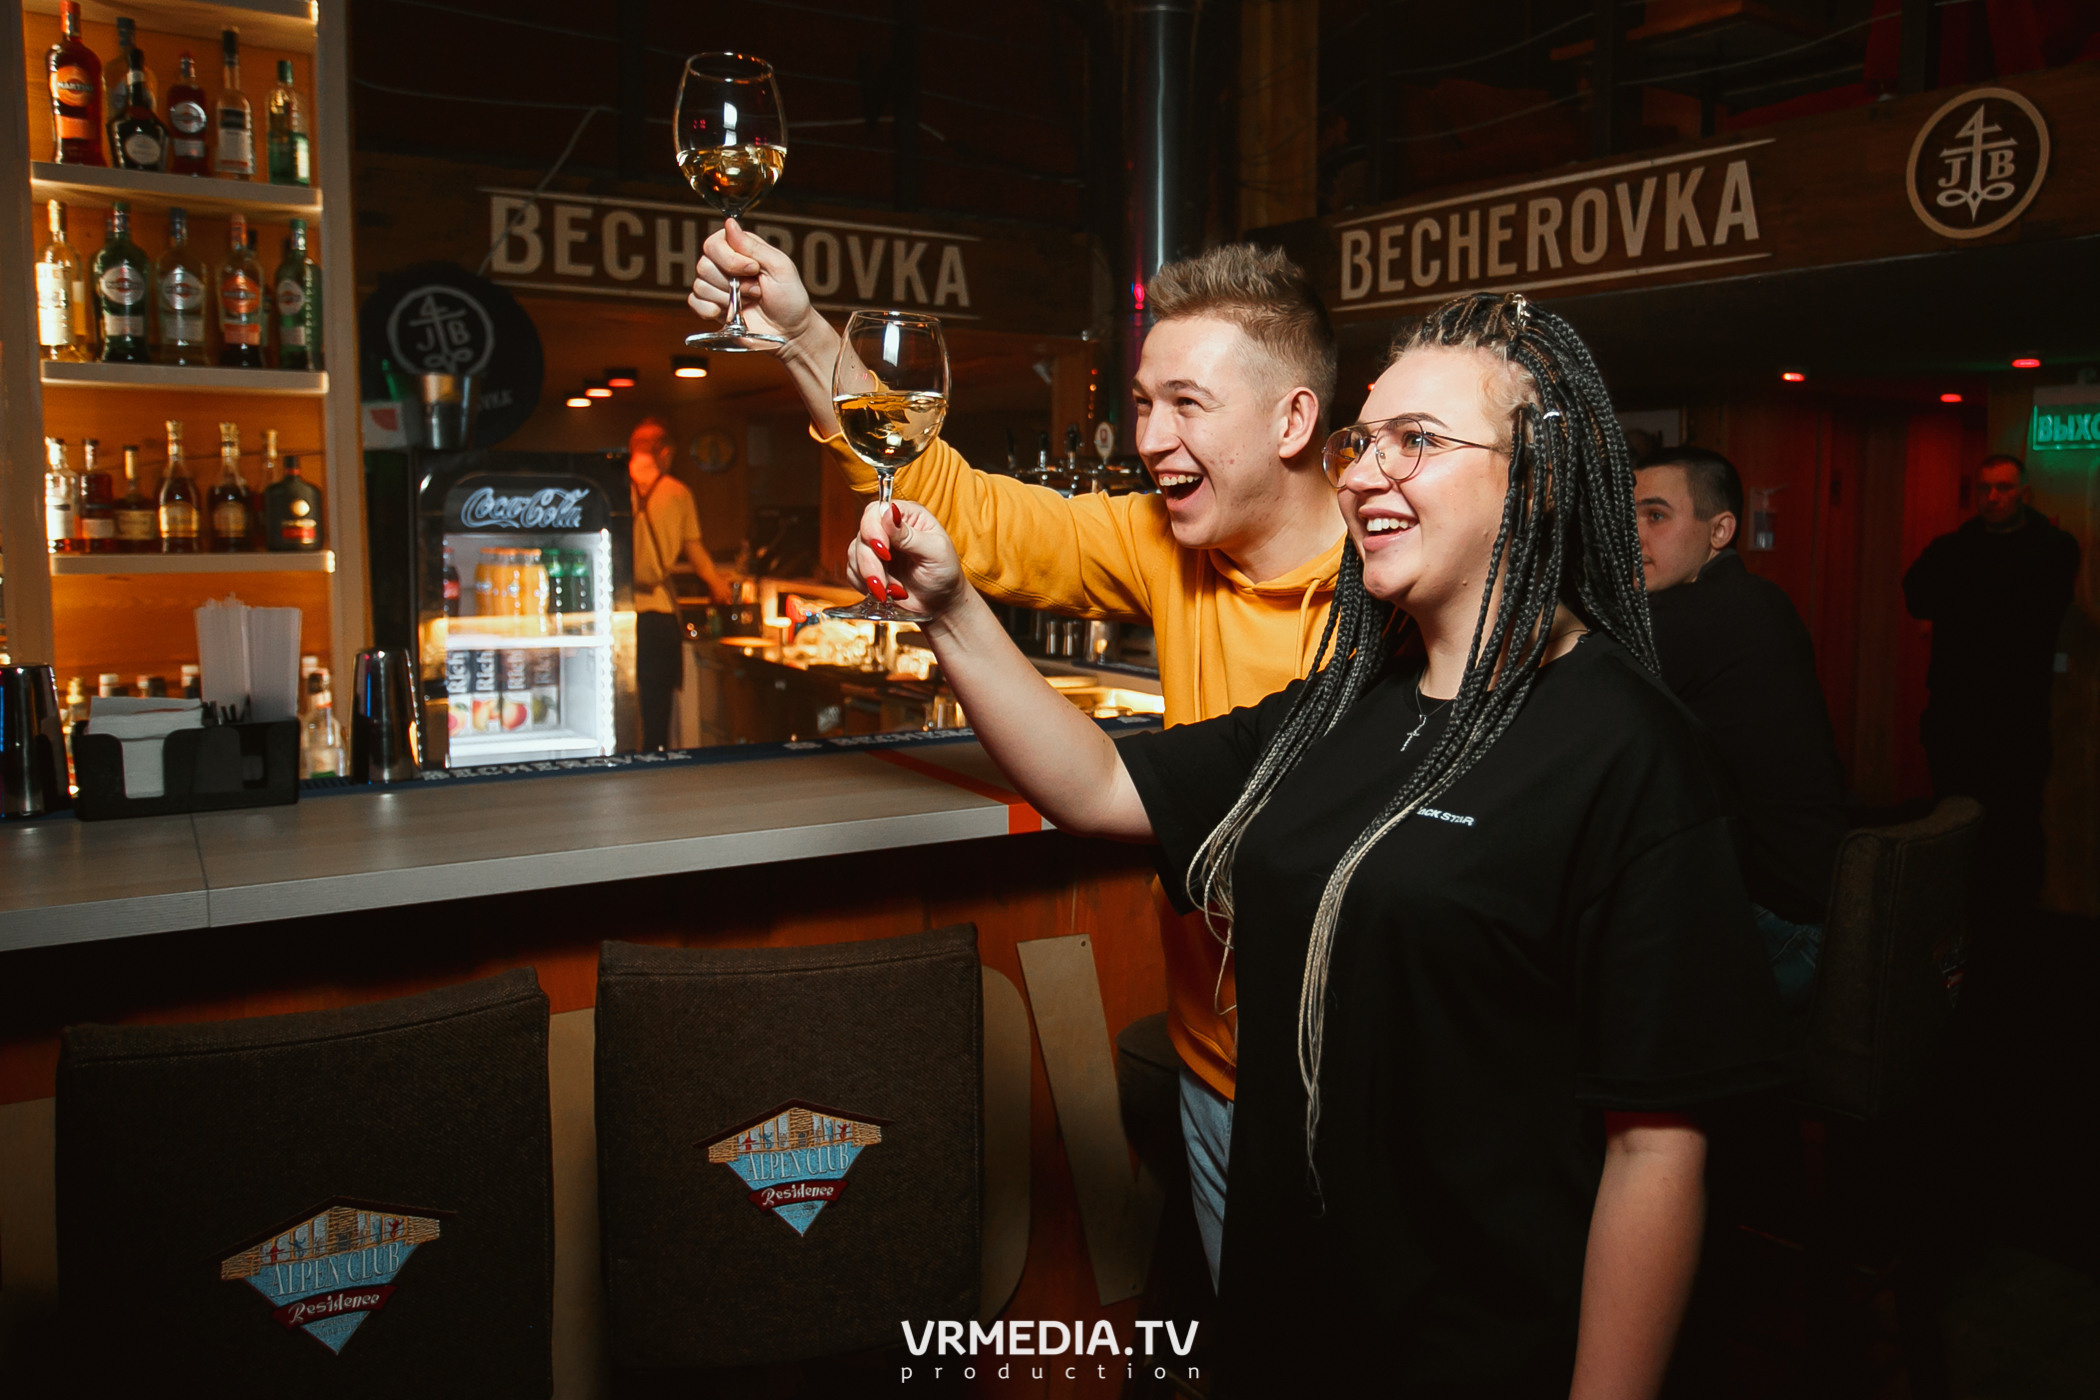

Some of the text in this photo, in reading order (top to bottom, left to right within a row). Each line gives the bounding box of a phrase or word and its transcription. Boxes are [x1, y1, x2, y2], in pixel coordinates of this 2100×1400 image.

[1340, 159, 1761, 301] BECHEROVKA
[490, 195, 971, 308] BECHOVKA
[460, 486, 591, 529] Coca-Cola
[475, 650, 496, 691] Rich
[1416, 808, 1443, 819] ACK
[746, 1142, 849, 1182] ALPEN CLUB
[761, 1183, 835, 1206] Residence
[269, 1242, 400, 1298] ALPEN CLUB
[287, 1293, 380, 1325] Residence
